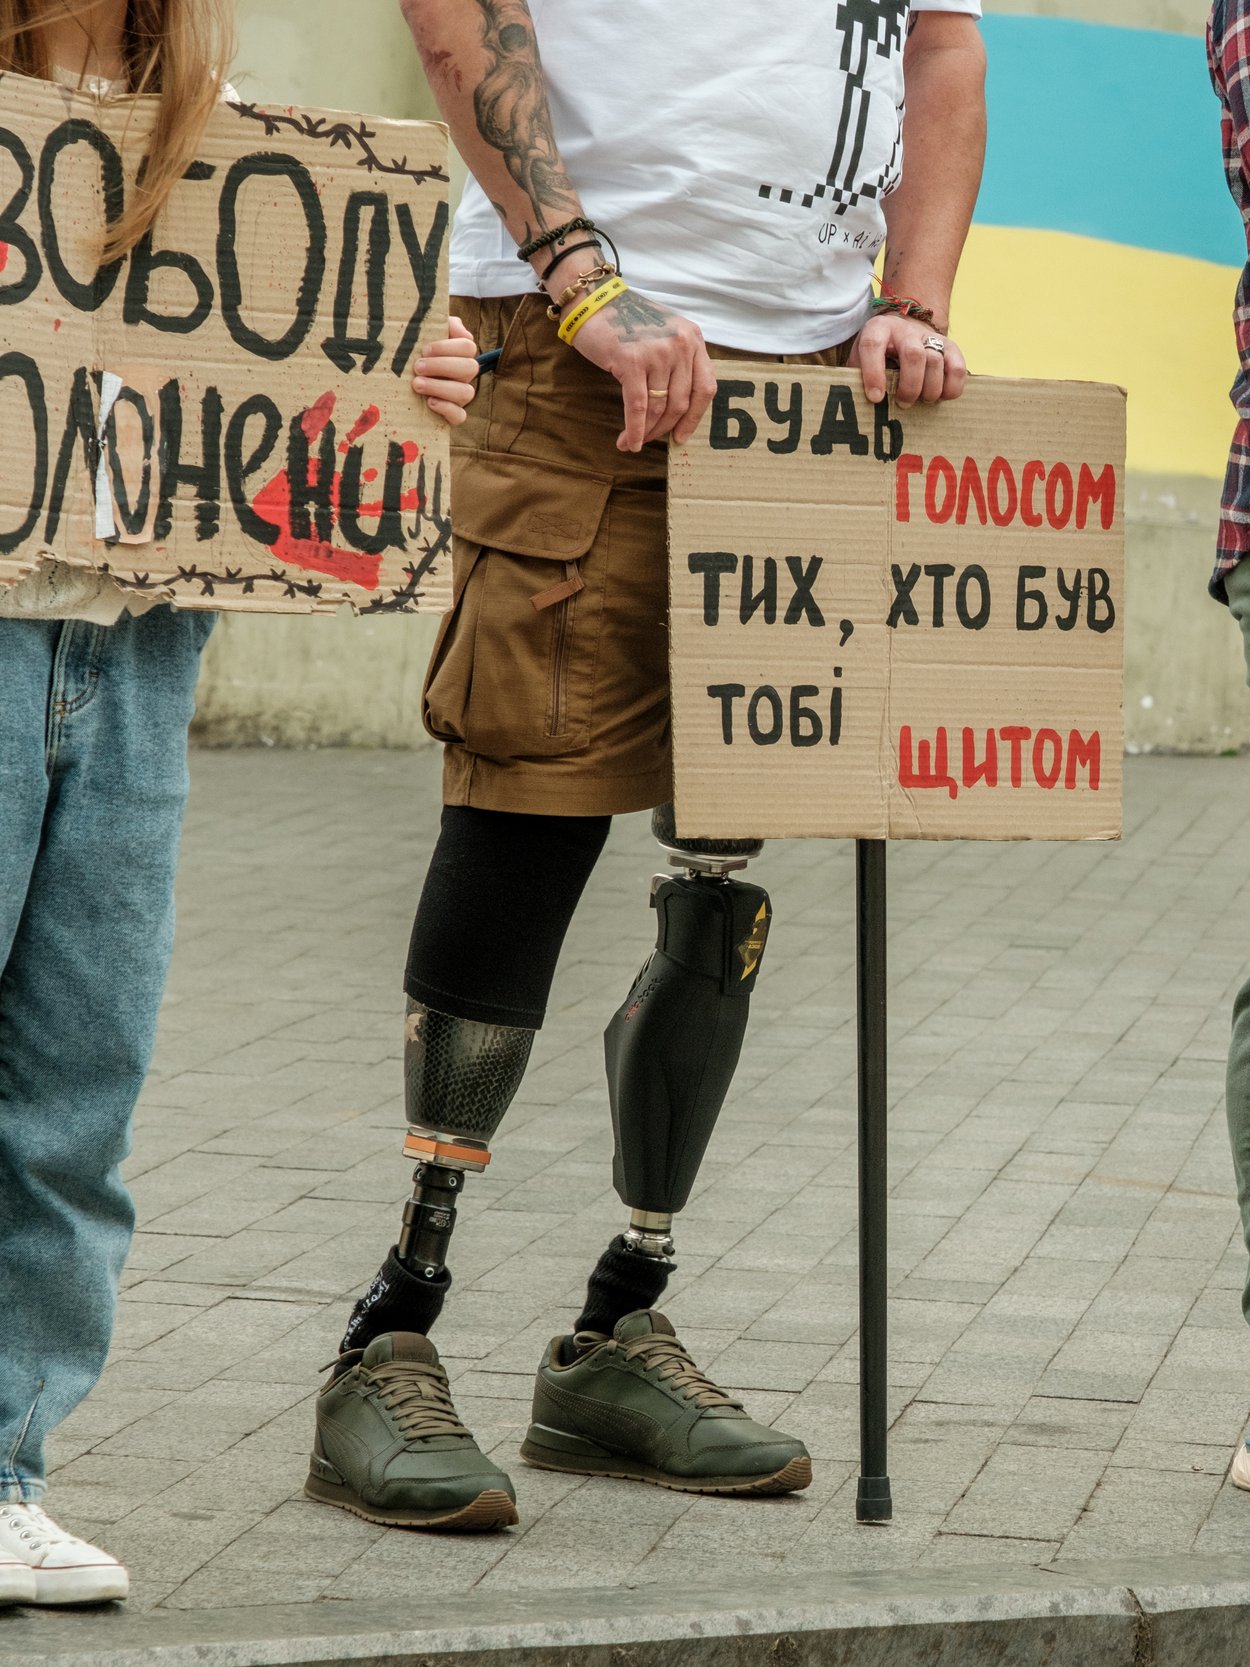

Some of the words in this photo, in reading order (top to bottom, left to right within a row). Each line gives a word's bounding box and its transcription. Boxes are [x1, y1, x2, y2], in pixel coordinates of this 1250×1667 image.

[708, 379, 904, 462] БУДЬ
[895, 454, 1116, 531] ГОЛОСОМ
[687, 551, 854, 648] ТИХ,
[886, 562, 991, 630] ХТО
[1016, 564, 1116, 634] БУВ
[898, 724, 1100, 800] ЩИТОМ
